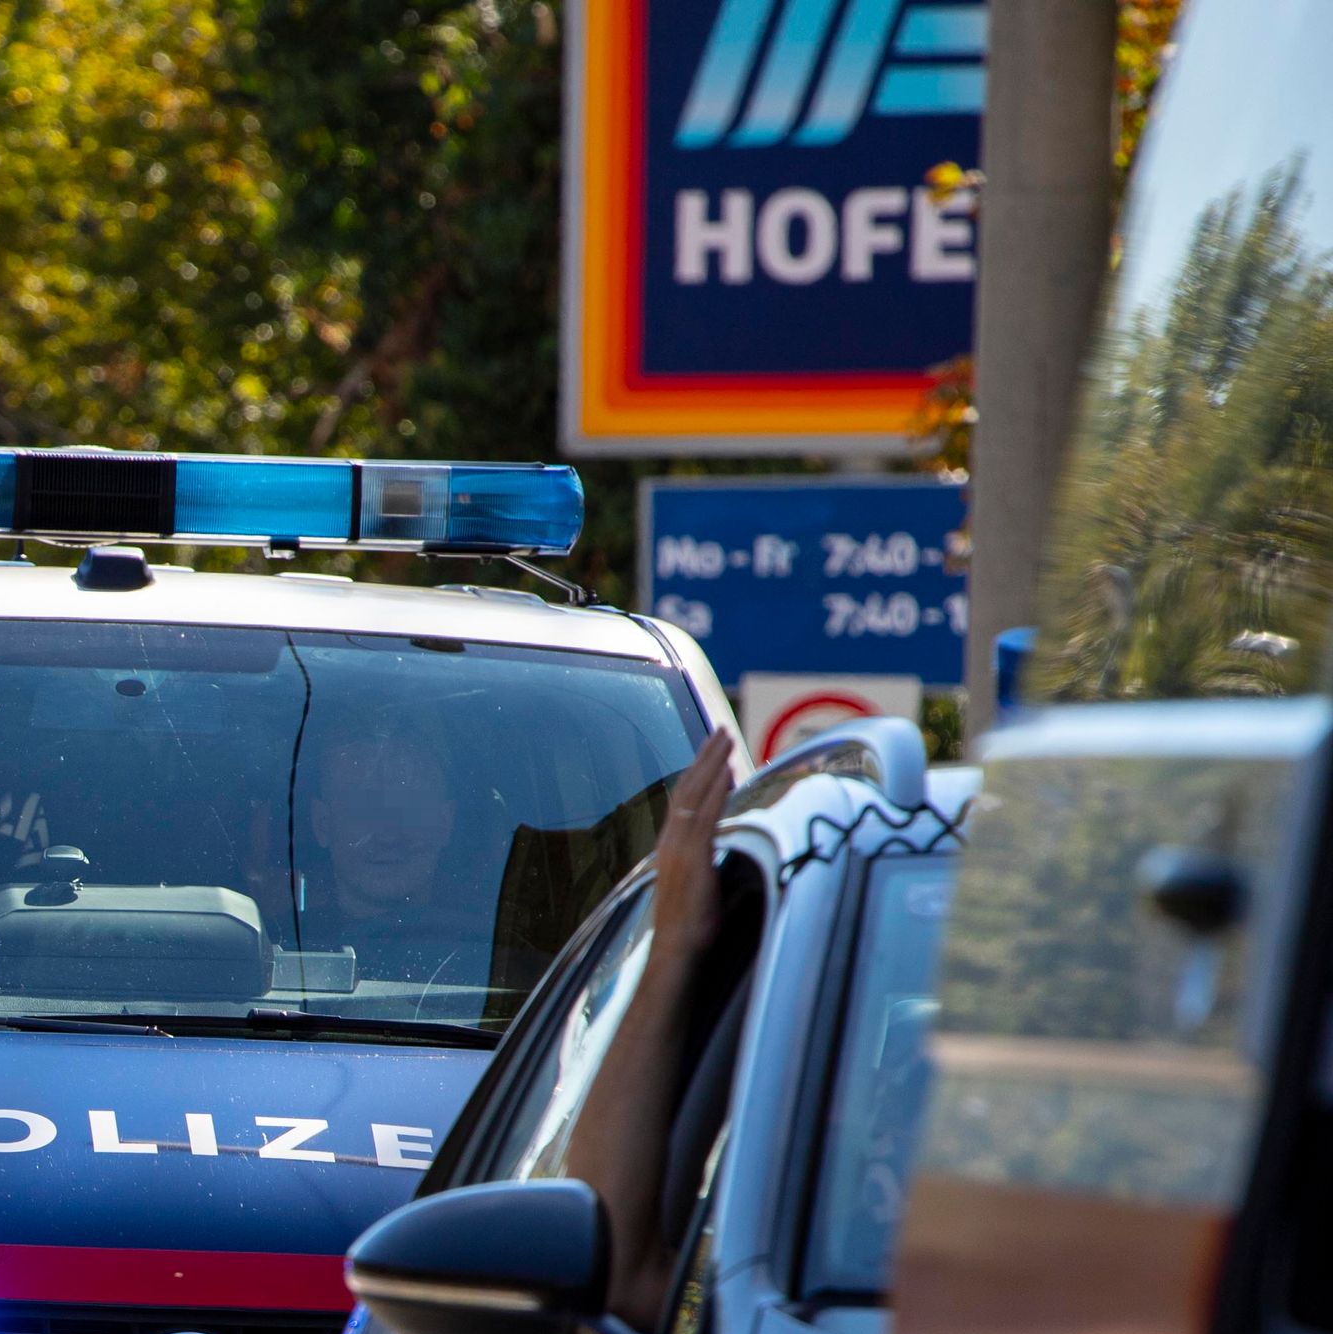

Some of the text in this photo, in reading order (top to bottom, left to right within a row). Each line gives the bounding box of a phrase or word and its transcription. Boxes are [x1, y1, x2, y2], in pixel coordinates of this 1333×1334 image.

[674, 185, 978, 286] HOFE
[820, 531, 918, 578] 7:40
[821, 592, 920, 638] 7:40
